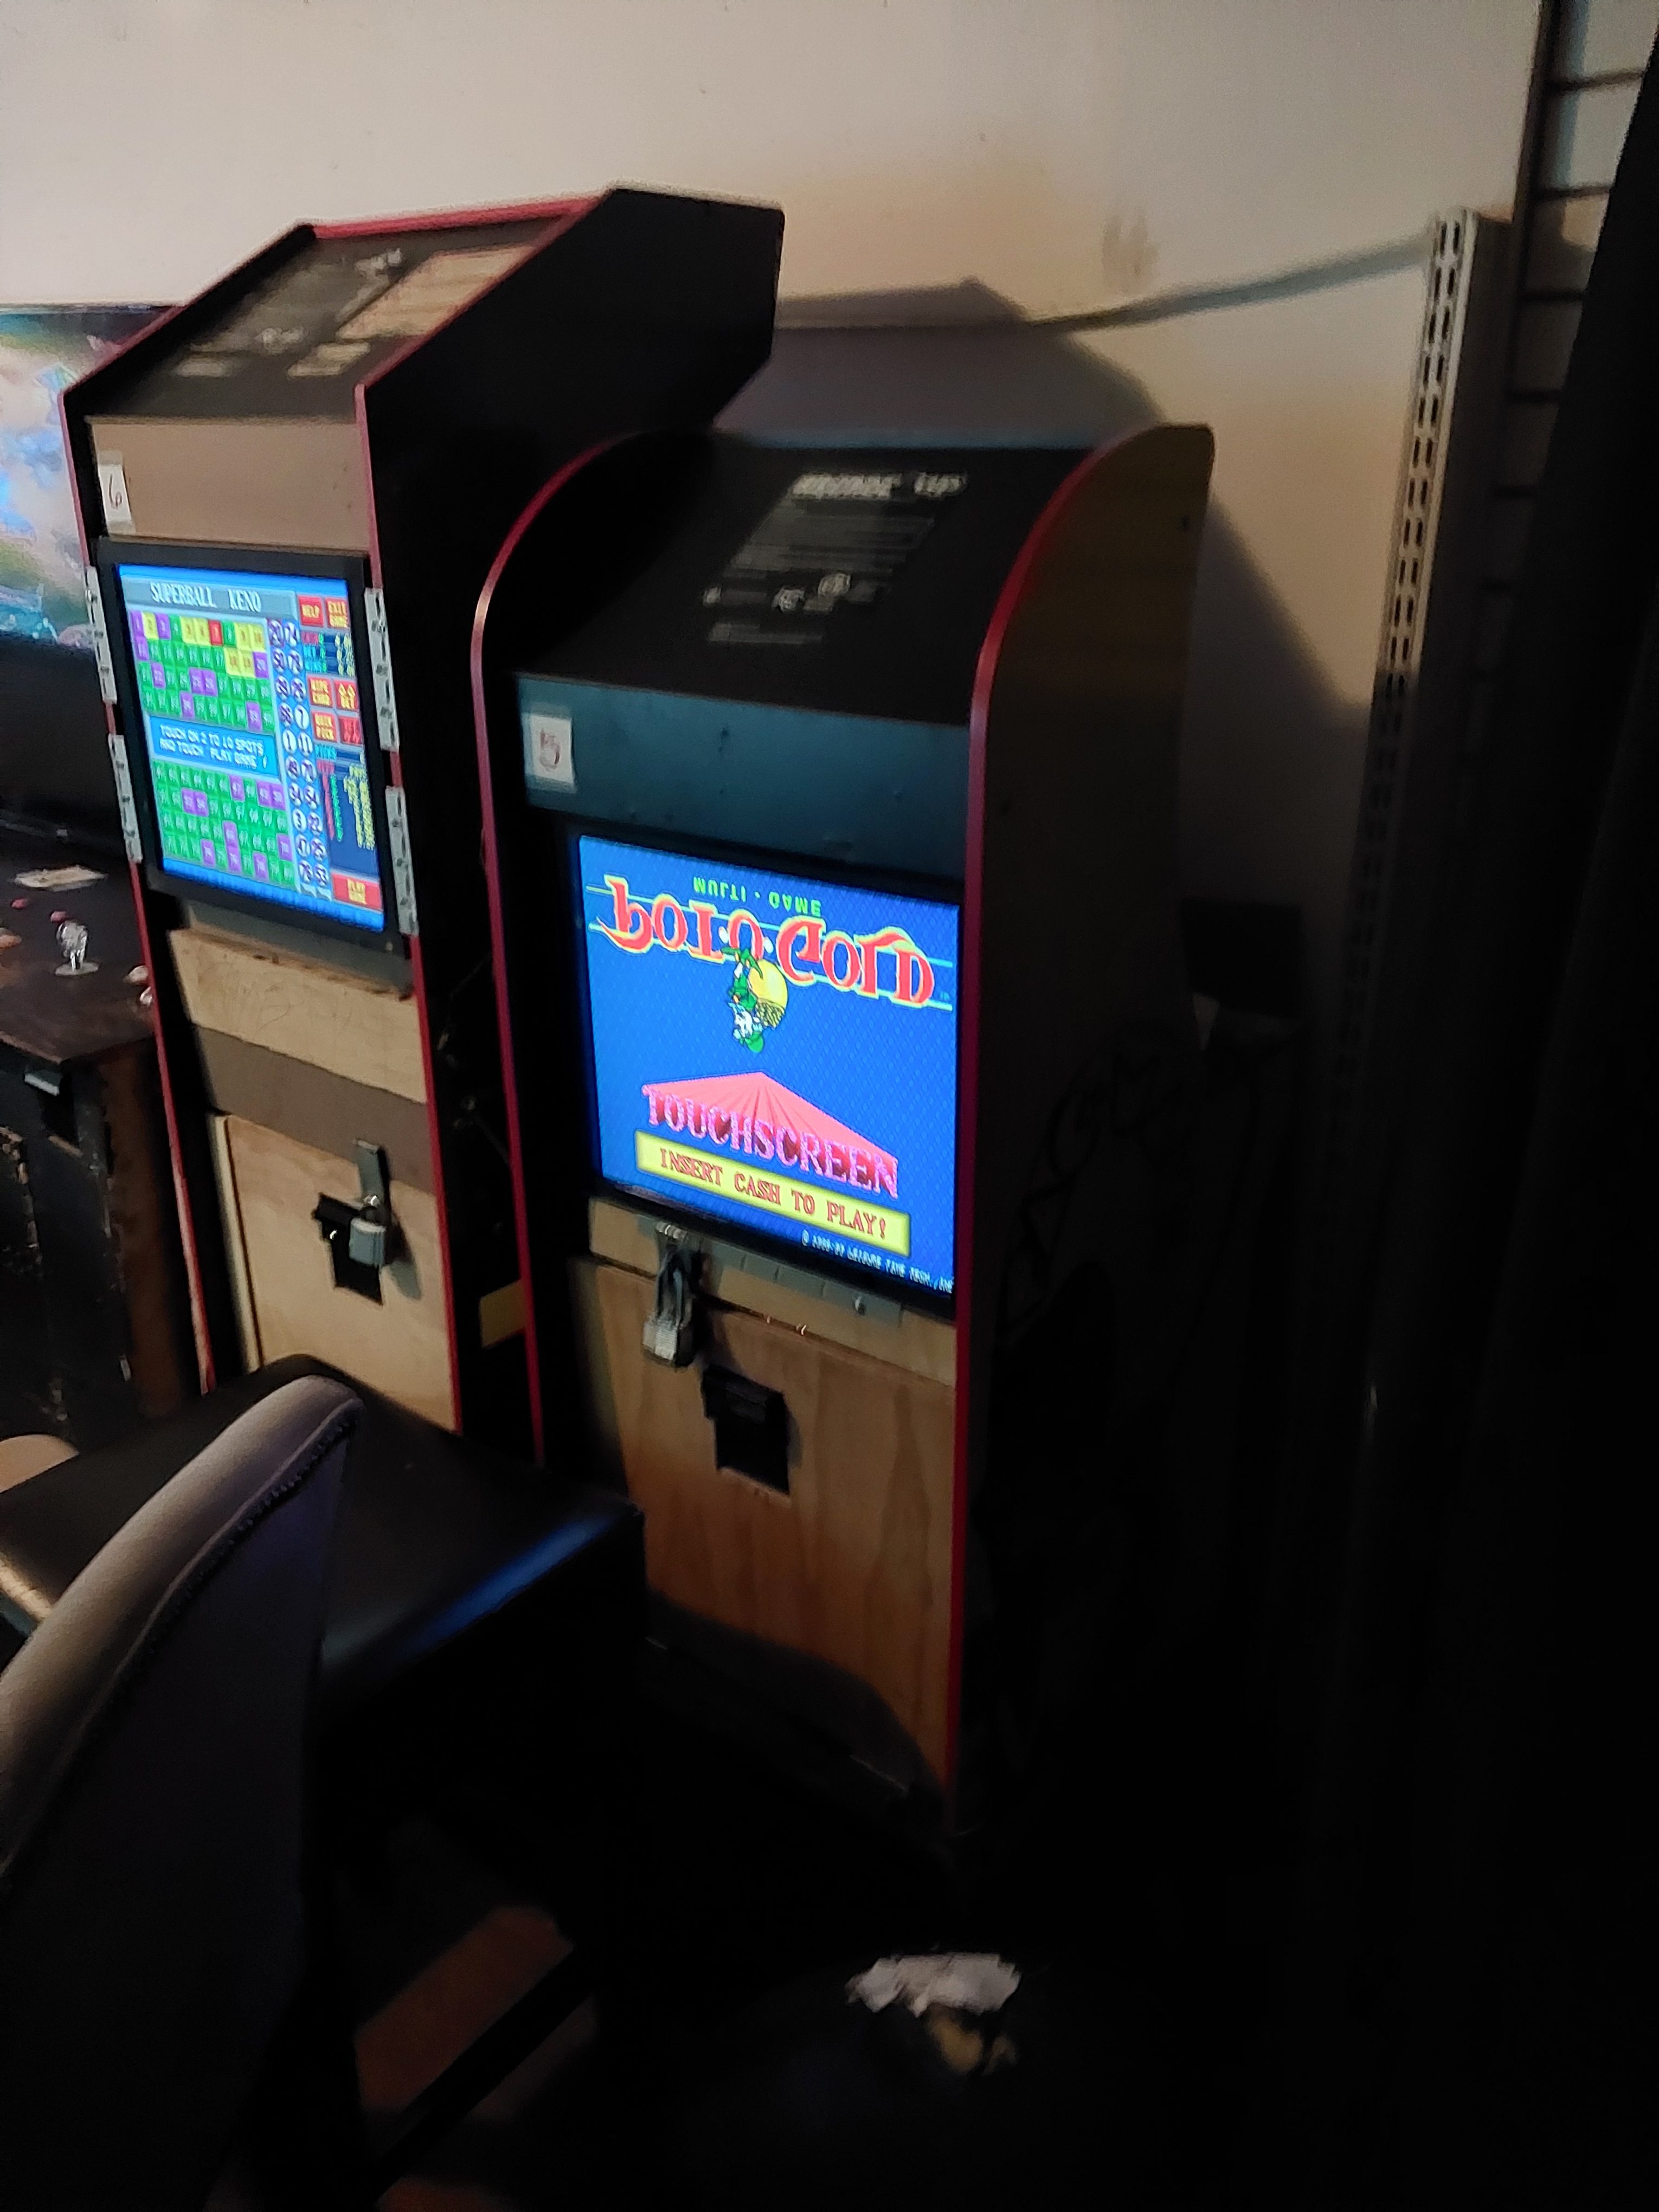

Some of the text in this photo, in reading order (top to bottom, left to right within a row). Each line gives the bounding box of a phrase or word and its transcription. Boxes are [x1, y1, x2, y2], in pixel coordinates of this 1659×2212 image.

[108, 473, 123, 510] 6
[150, 581, 261, 613] SUPERBALL KENO
[208, 732, 220, 747] TO
[235, 738, 264, 757] SPOTS
[300, 734, 311, 754] 11
[647, 1087, 898, 1200] TOUCHSCREEN
[659, 1148, 887, 1239] INSERT CASH TO PLAY!
